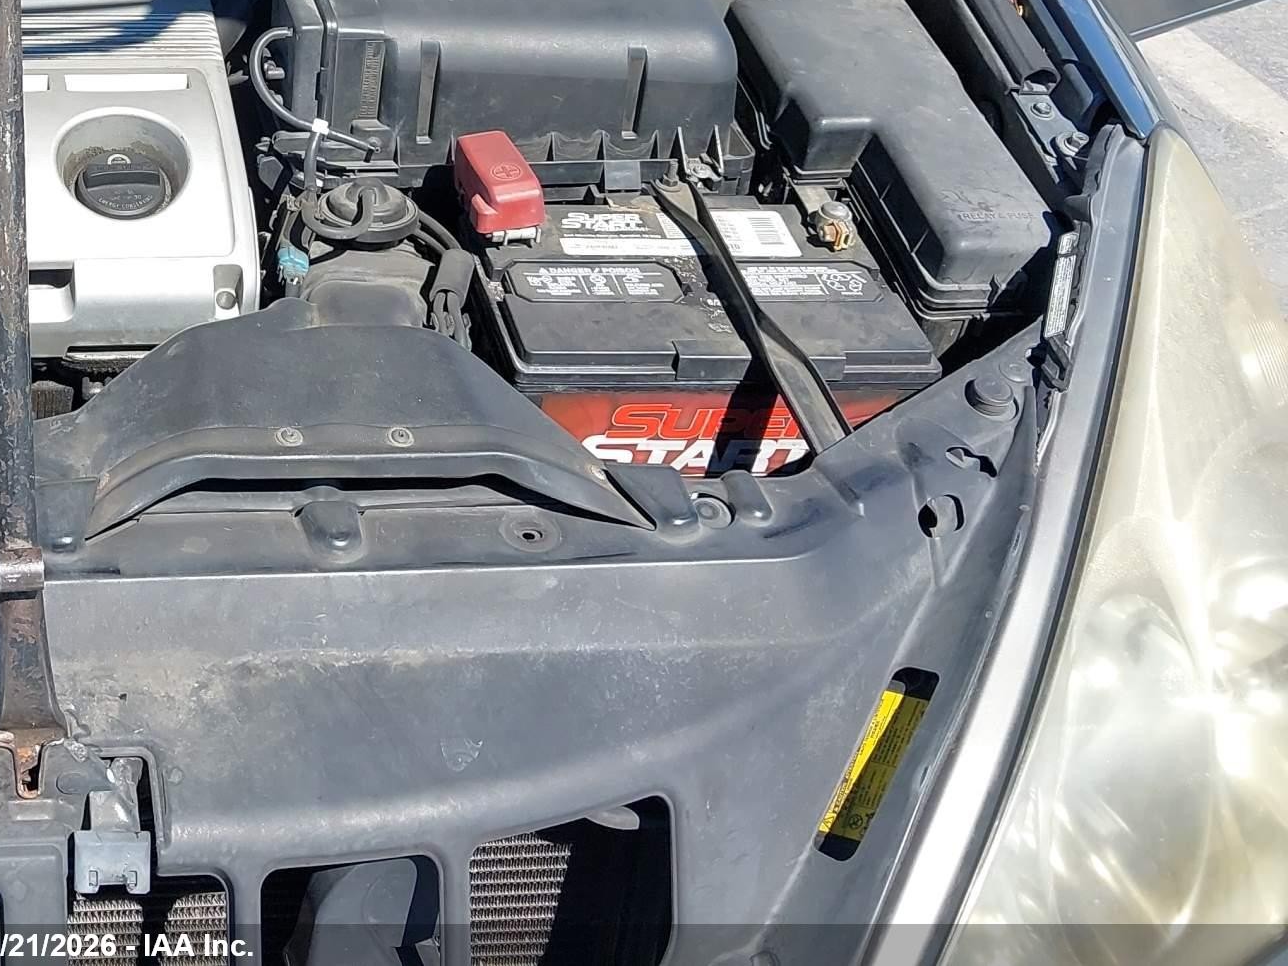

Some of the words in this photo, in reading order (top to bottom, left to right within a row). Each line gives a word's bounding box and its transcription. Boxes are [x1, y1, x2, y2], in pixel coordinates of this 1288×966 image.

[561, 218, 643, 230] START
[567, 212, 643, 225] SUPER
[549, 267, 592, 275] DANGER
[582, 435, 810, 473] START
